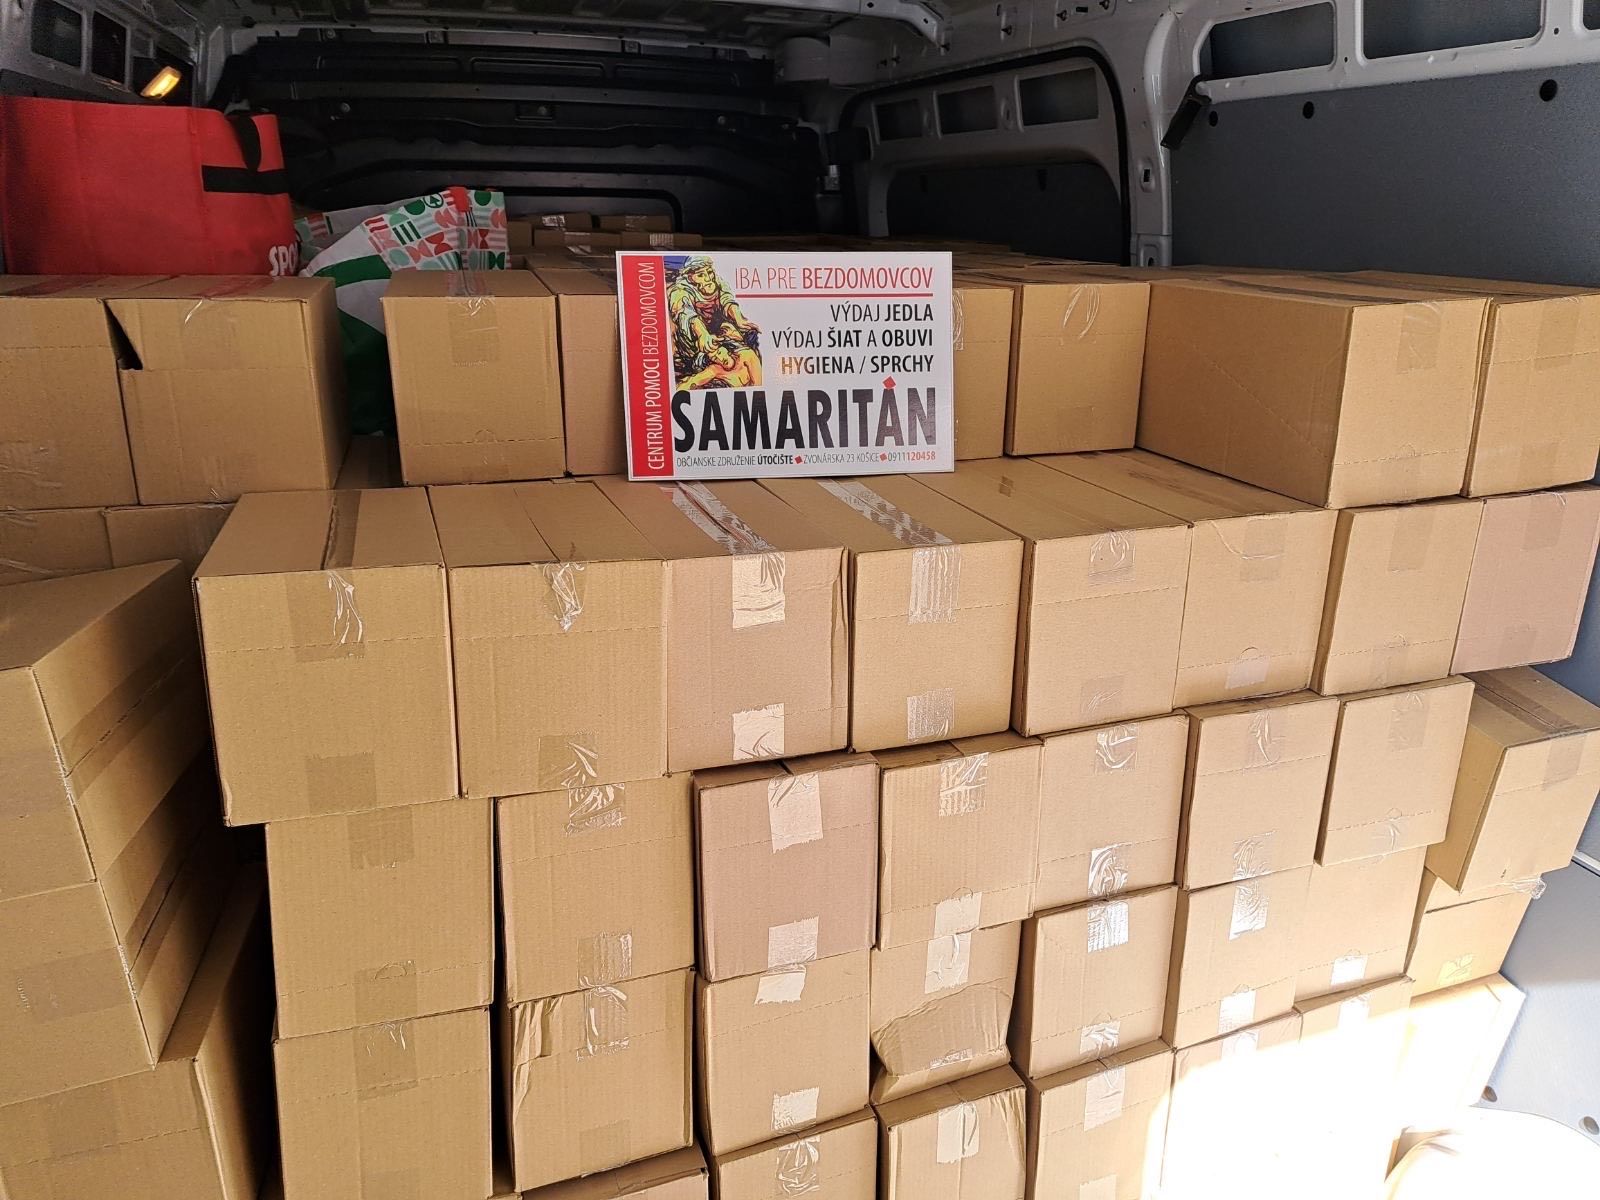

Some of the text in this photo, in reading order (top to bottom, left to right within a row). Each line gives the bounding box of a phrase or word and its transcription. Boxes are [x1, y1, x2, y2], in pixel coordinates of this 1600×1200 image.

[735, 267, 933, 289] IBA PRE BEZDOMOVCOV
[830, 300, 934, 322] VÝDAJ JEDLA
[771, 326, 933, 348] VÝDAJ ŠIAT A OBUVI
[638, 262, 665, 470] CENTRUM POMOCI BEZDOMOVCOM
[781, 355, 934, 375] HYGIENA / SPRCHY
[671, 376, 936, 453] SAMARITÁN
[676, 450, 936, 468] OBČIANSKE ZDRUŽENIE ÚTOČIŠTE ZVONÁRSKA 23 KOŠICE 0911120458
